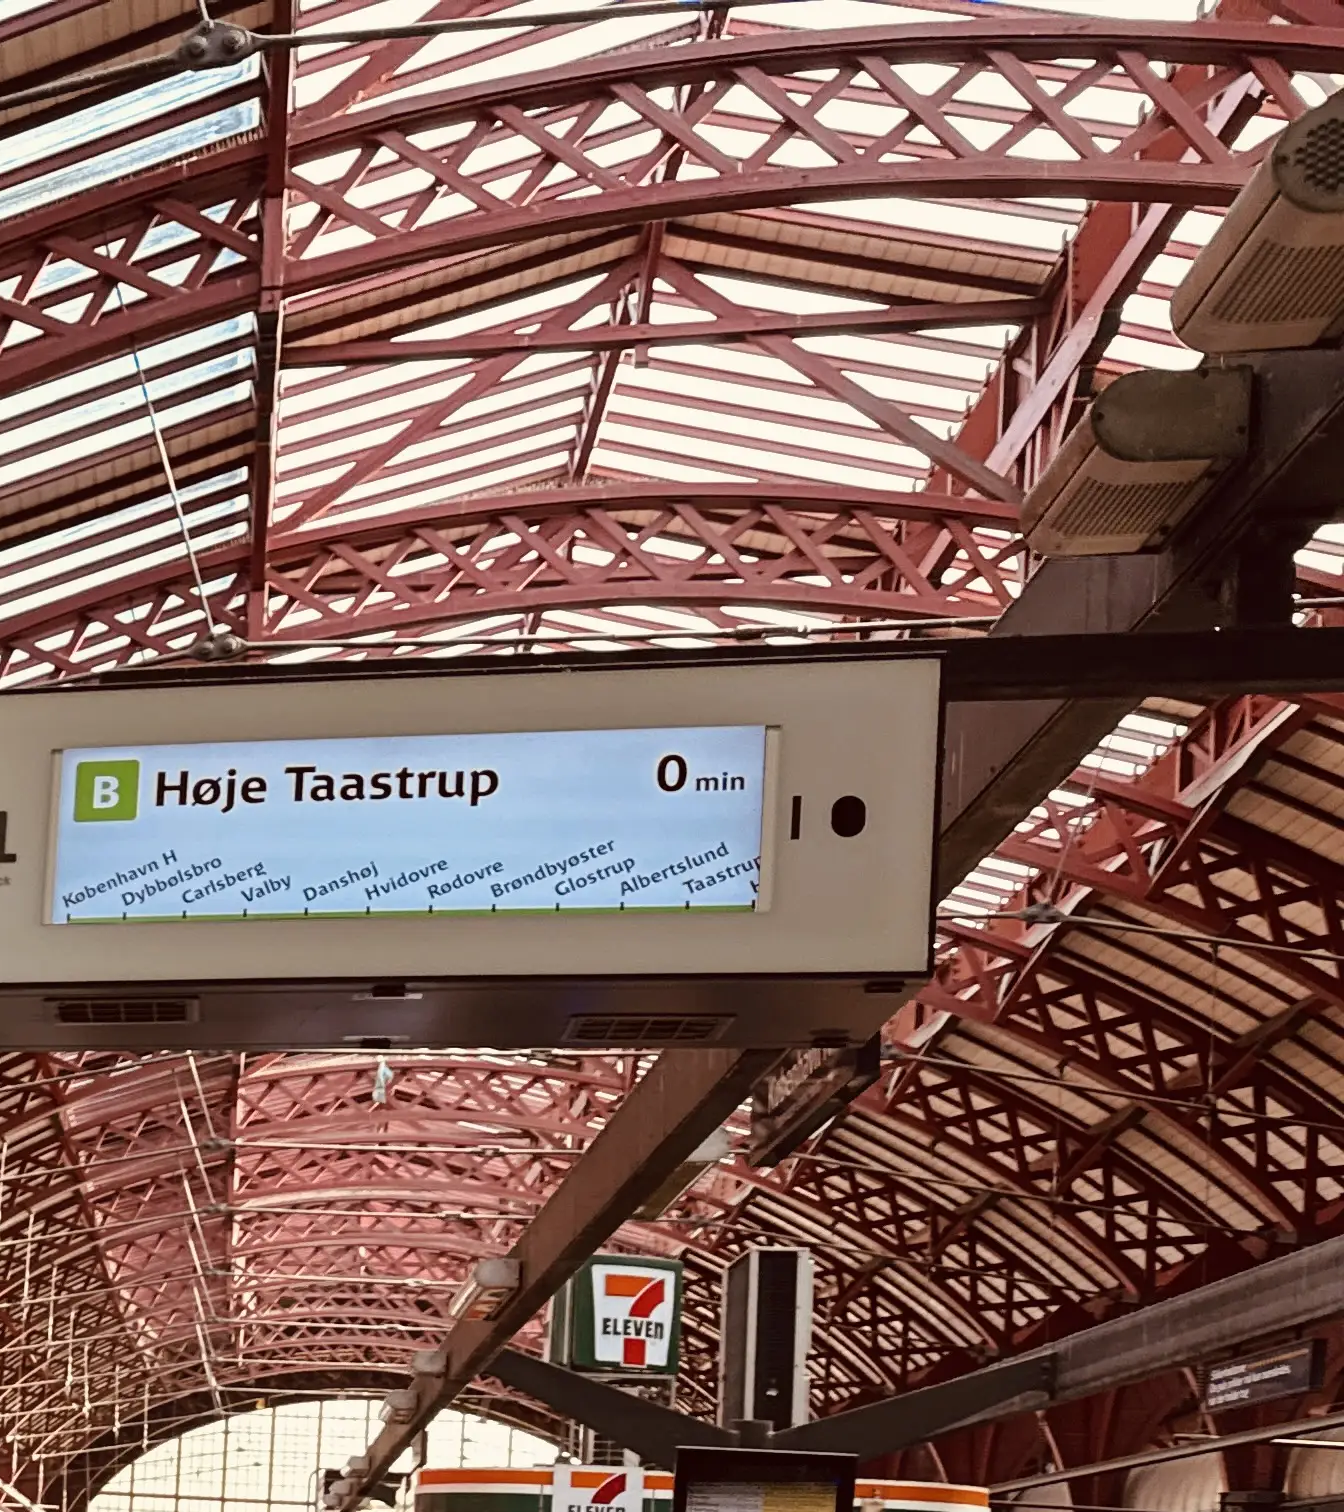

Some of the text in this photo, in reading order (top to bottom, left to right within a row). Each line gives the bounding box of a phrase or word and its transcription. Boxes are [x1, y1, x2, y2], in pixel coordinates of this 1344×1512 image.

[92, 766, 499, 813] B Høje Taastrup
[657, 754, 745, 792] 0 min
[62, 849, 179, 909] København H
[121, 856, 222, 907] Dybbølsbro
[182, 861, 268, 904] Carlsberg
[241, 874, 292, 903] Valby
[303, 861, 380, 902] Danshøj
[365, 857, 449, 901] Hvidovre
[428, 859, 504, 899] Rødovre
[490, 839, 615, 898] Brøndbyøster
[554, 855, 636, 897] Glostrup
[619, 841, 729, 896] Albertslund
